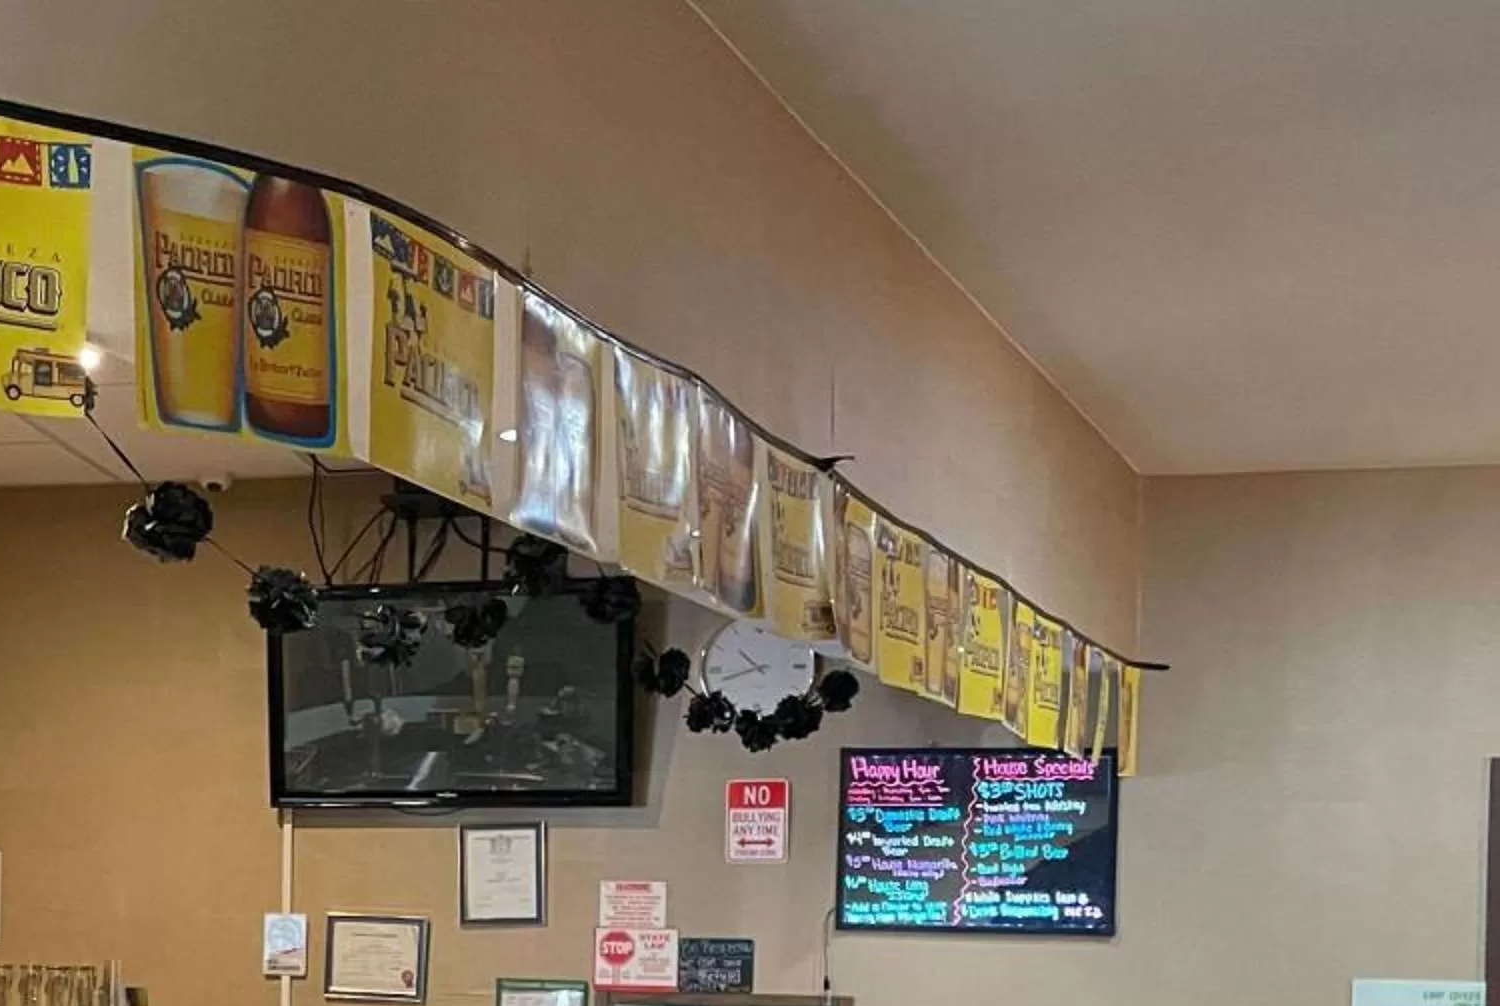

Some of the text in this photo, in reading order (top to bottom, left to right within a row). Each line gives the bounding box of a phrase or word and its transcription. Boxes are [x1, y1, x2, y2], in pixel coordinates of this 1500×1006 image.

[851, 756, 941, 783] Happy Hour
[983, 756, 1095, 780] House Specials
[743, 785, 772, 805] NO
[1014, 781, 1065, 801] SHOTS
[731, 811, 782, 823] BULLYING
[922, 835, 955, 847] Draft
[602, 941, 633, 955] STOP
